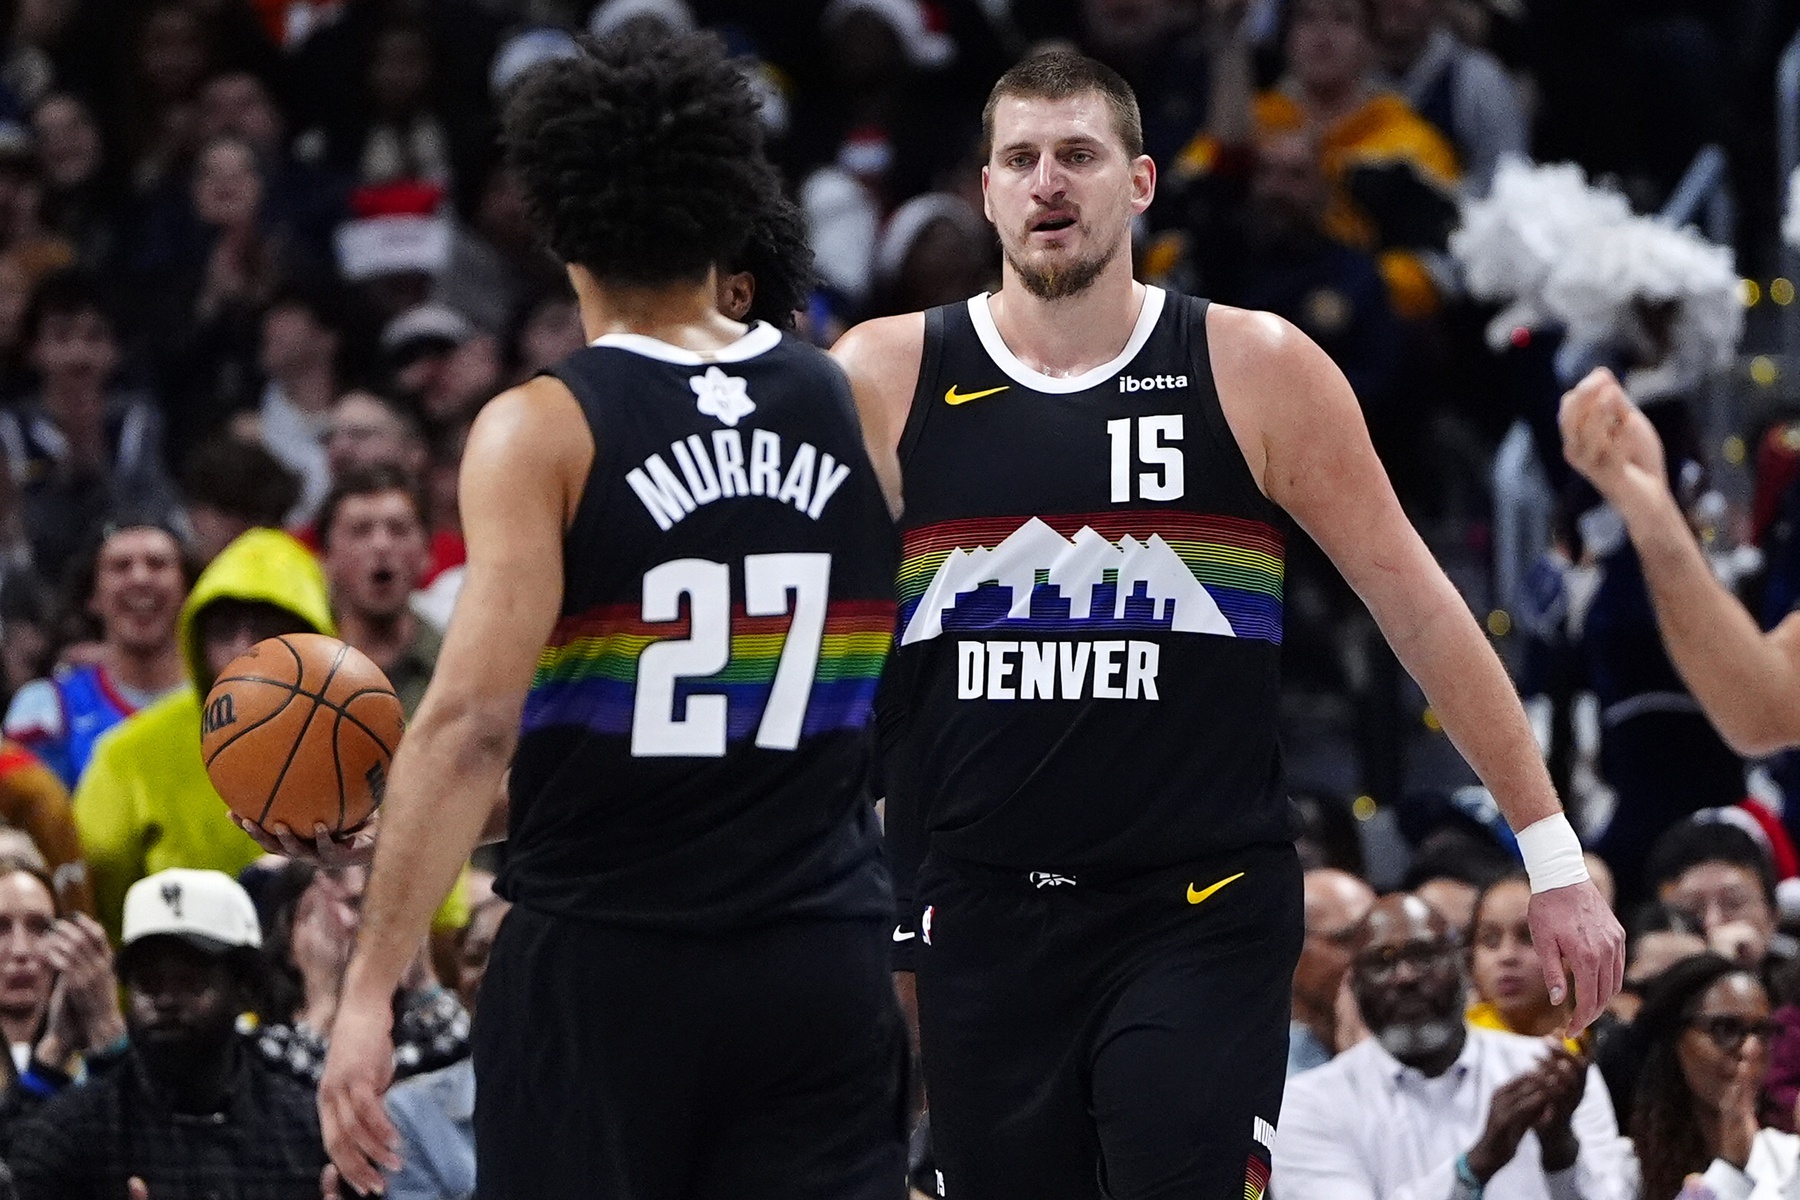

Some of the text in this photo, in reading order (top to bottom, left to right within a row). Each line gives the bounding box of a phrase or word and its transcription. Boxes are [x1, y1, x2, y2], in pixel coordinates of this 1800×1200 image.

[1119, 374, 1188, 393] ibotta
[625, 427, 850, 531] MURRAY
[1106, 413, 1185, 503] 15
[630, 552, 832, 757] 27
[957, 640, 1160, 701] DENVER
